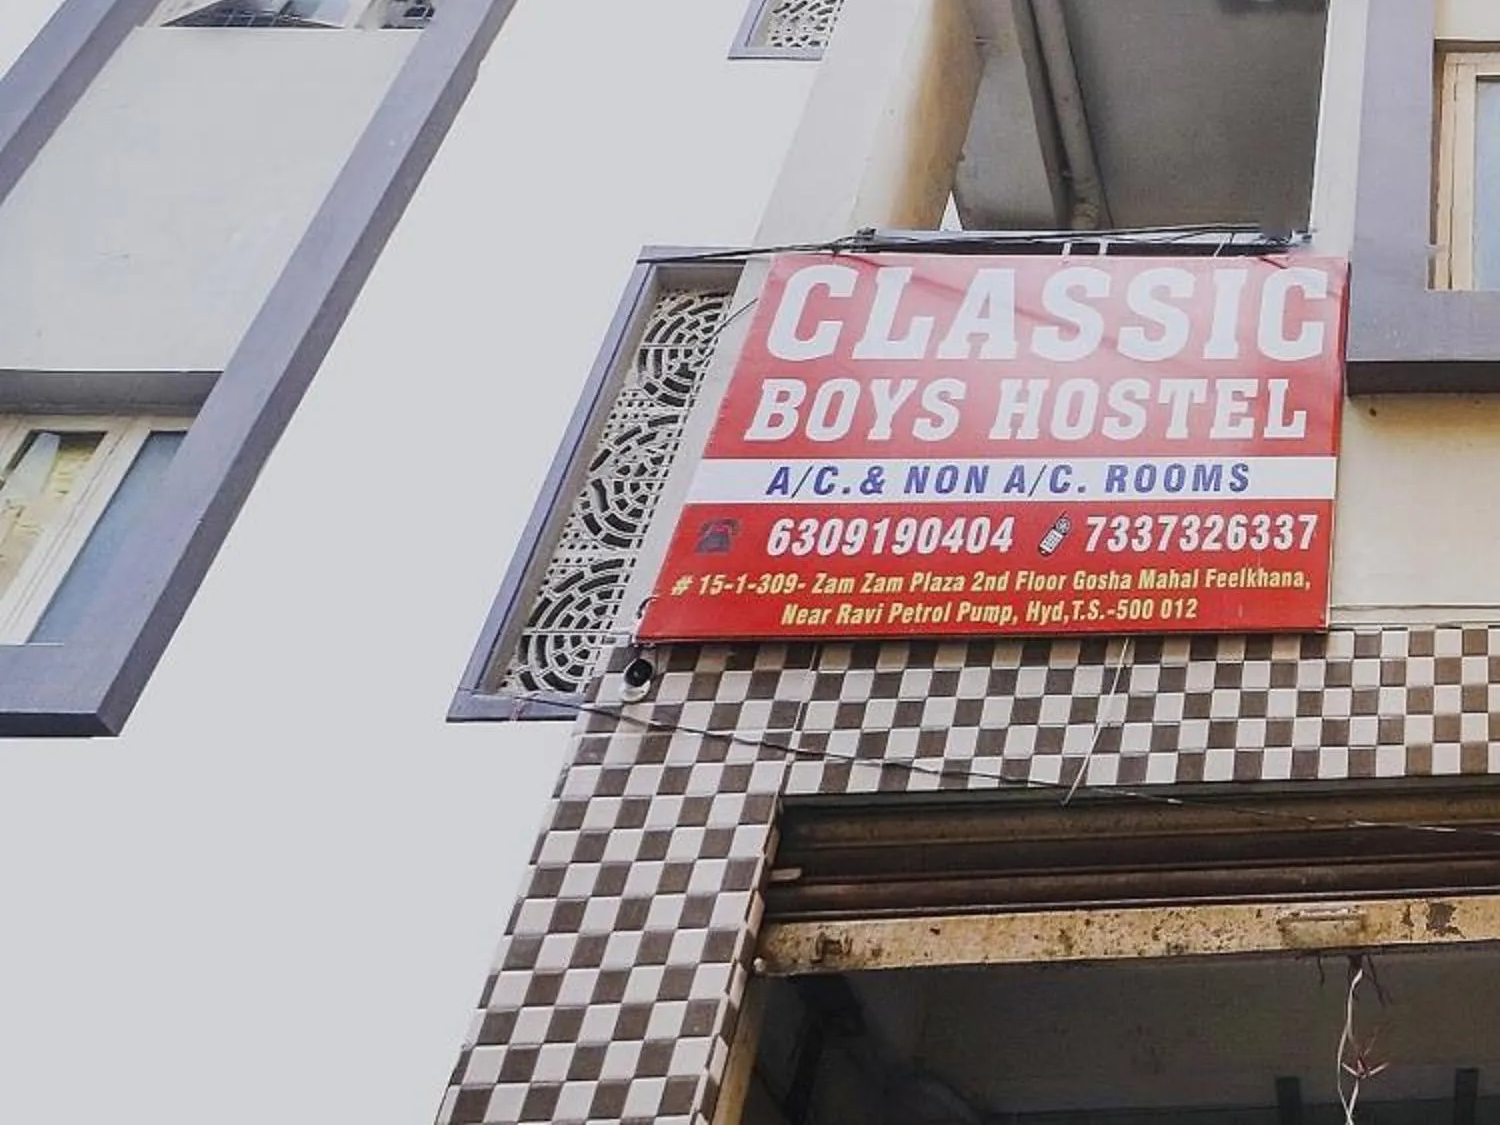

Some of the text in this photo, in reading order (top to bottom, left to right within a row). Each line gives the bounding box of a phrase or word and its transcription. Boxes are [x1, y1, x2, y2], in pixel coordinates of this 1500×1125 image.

[767, 264, 1329, 362] CLASSIC
[744, 378, 1307, 442] BOYS HOSTEL
[903, 465, 989, 494] NON
[1004, 463, 1087, 497] A/C.
[1105, 462, 1251, 493] ROOMS
[767, 513, 1319, 556] 6309190404 7337326337
[671, 575, 693, 596] #
[811, 572, 853, 594] Zam
[860, 572, 901, 593] Zam
[909, 571, 964, 592] Plaza
[970, 570, 1009, 592] 2nd
[1015, 570, 1067, 591] Floor
[1073, 570, 1132, 591] Gosha
[1137, 569, 1199, 590] Mahal
[1205, 567, 1312, 590] Feelkhana,
[781, 603, 832, 625] Near
[836, 602, 883, 624] Ravi
[888, 601, 952, 624] Petrol
[956, 601, 1018, 625] Pump,
[1160, 599, 1199, 620] 012
